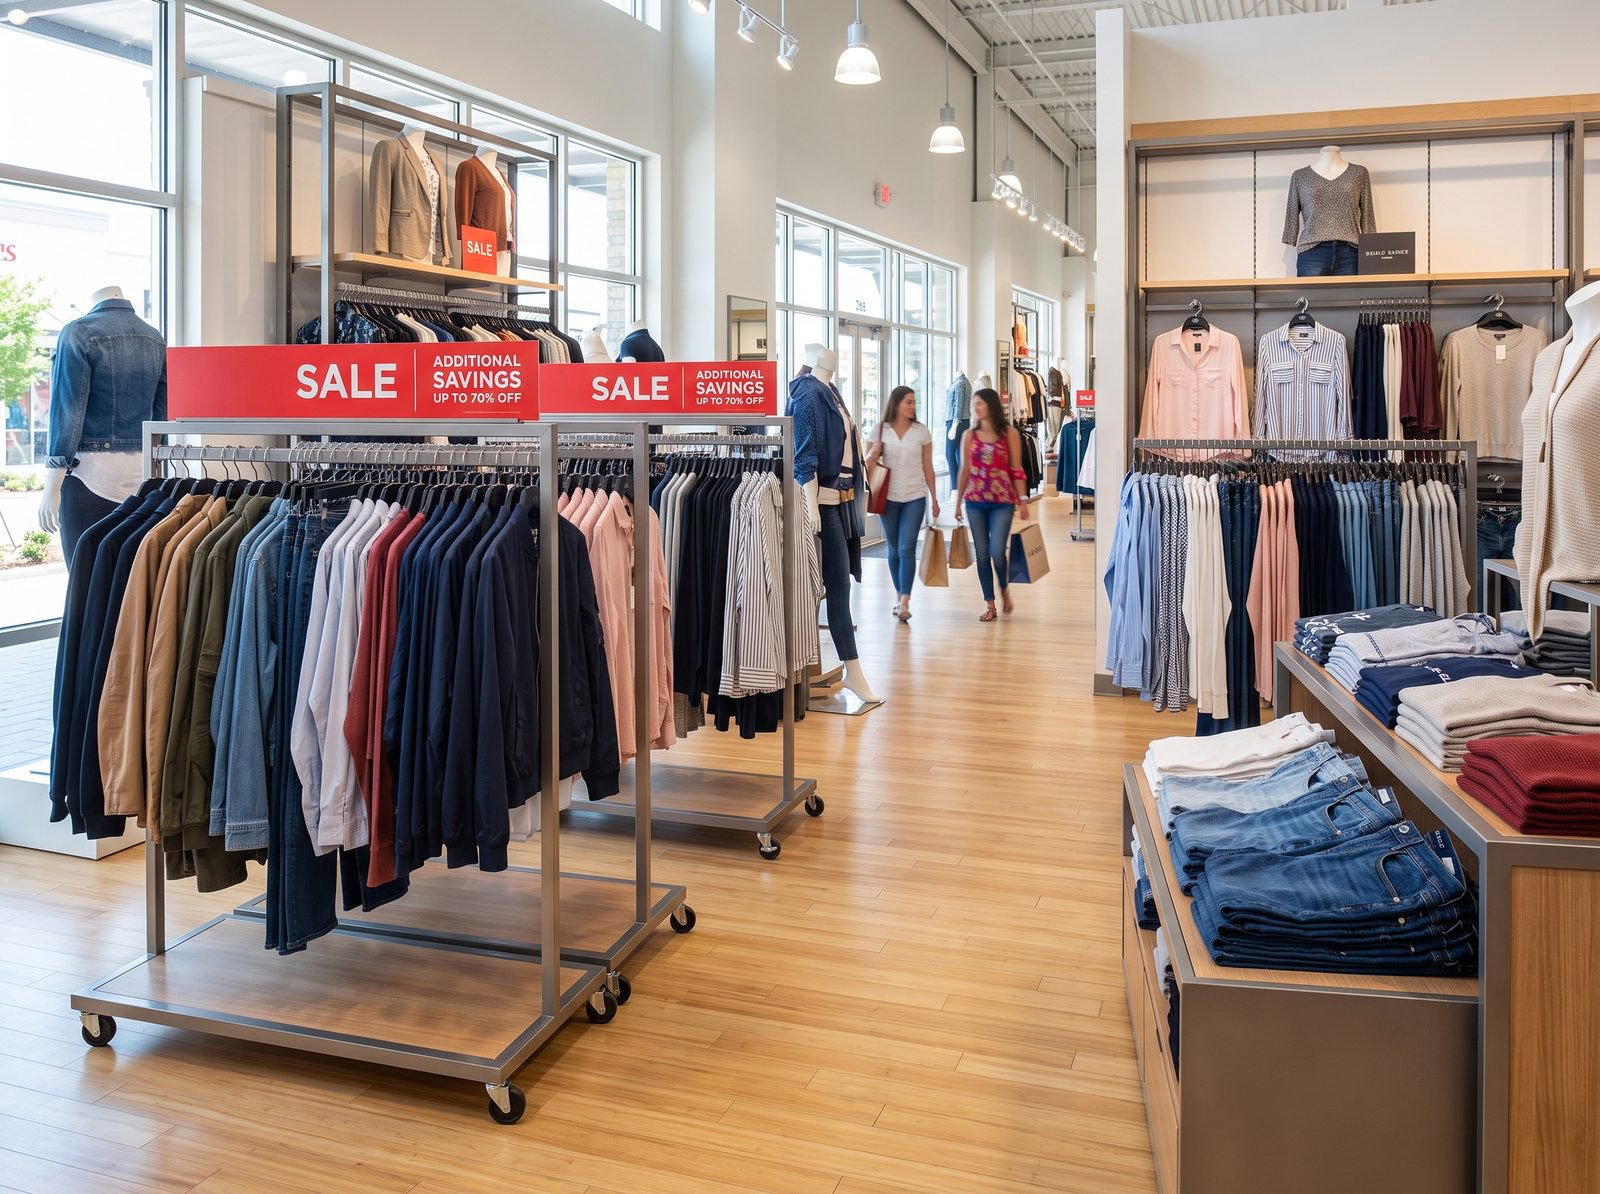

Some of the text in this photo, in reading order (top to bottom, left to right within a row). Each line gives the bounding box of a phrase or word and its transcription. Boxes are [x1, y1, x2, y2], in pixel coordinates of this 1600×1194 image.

[467, 240, 493, 257] SALE
[433, 354, 522, 368] ADDITIONAL
[296, 363, 398, 399] SALE
[433, 370, 522, 389] SAVINGS
[696, 369, 764, 380] ADDITIONAL
[591, 376, 670, 401] SALE
[696, 381, 765, 395] SAVINGS
[433, 392, 522, 404] UP TO 70% OFF
[696, 396, 764, 405] UP TO 70% OFF
